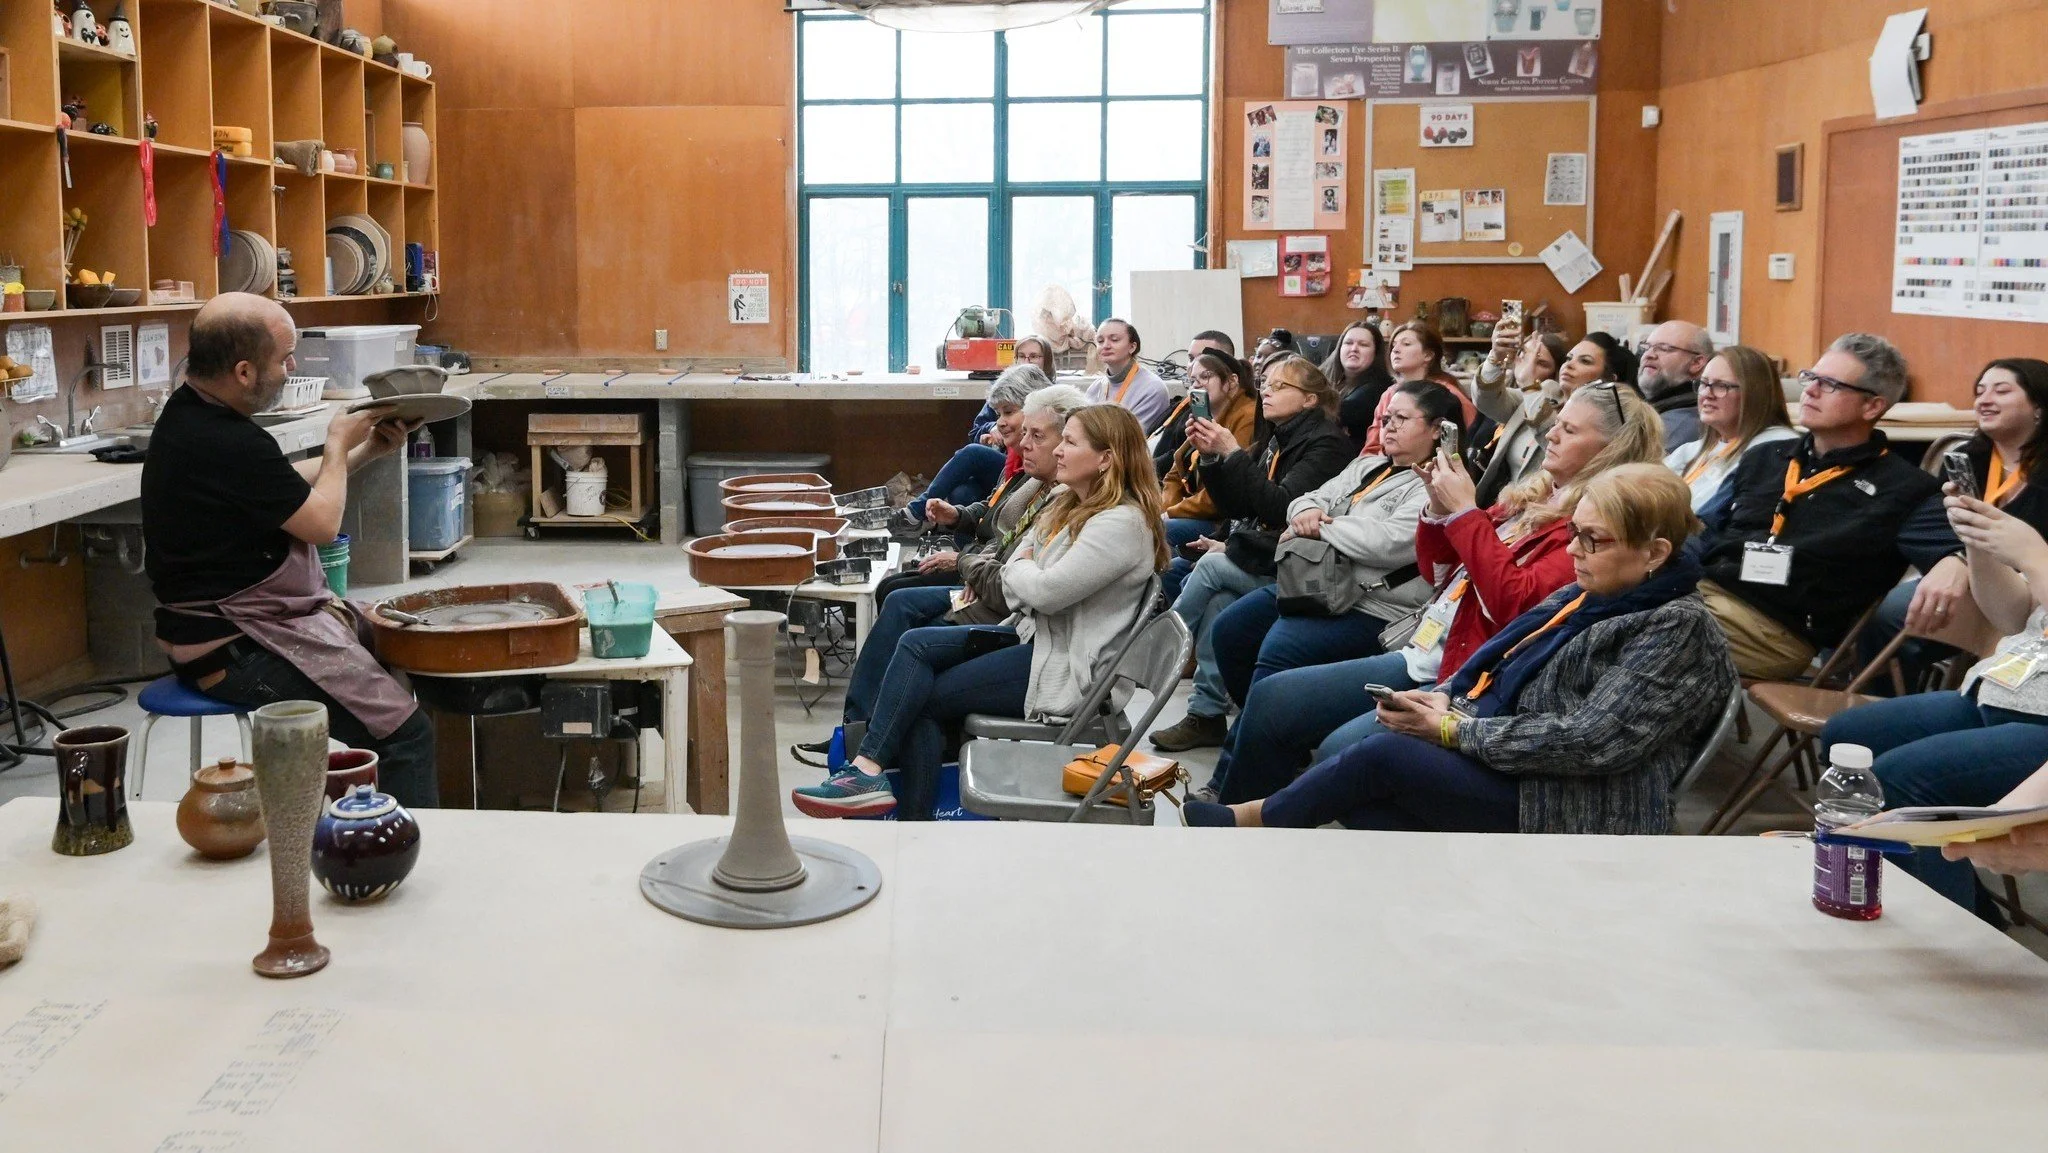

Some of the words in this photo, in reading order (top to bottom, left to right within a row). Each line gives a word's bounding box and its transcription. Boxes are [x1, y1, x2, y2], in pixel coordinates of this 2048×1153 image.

[1296, 46, 1311, 55] The
[1312, 46, 1350, 55] Collectors
[1352, 45, 1366, 54] Eye
[1367, 45, 1391, 53] Series
[1330, 55, 1353, 63] Seven
[1354, 54, 1402, 64] Perspectives
[1431, 113, 1442, 121] 90
[1445, 113, 1468, 121] DAYS
[997, 343, 1014, 351] CAU
